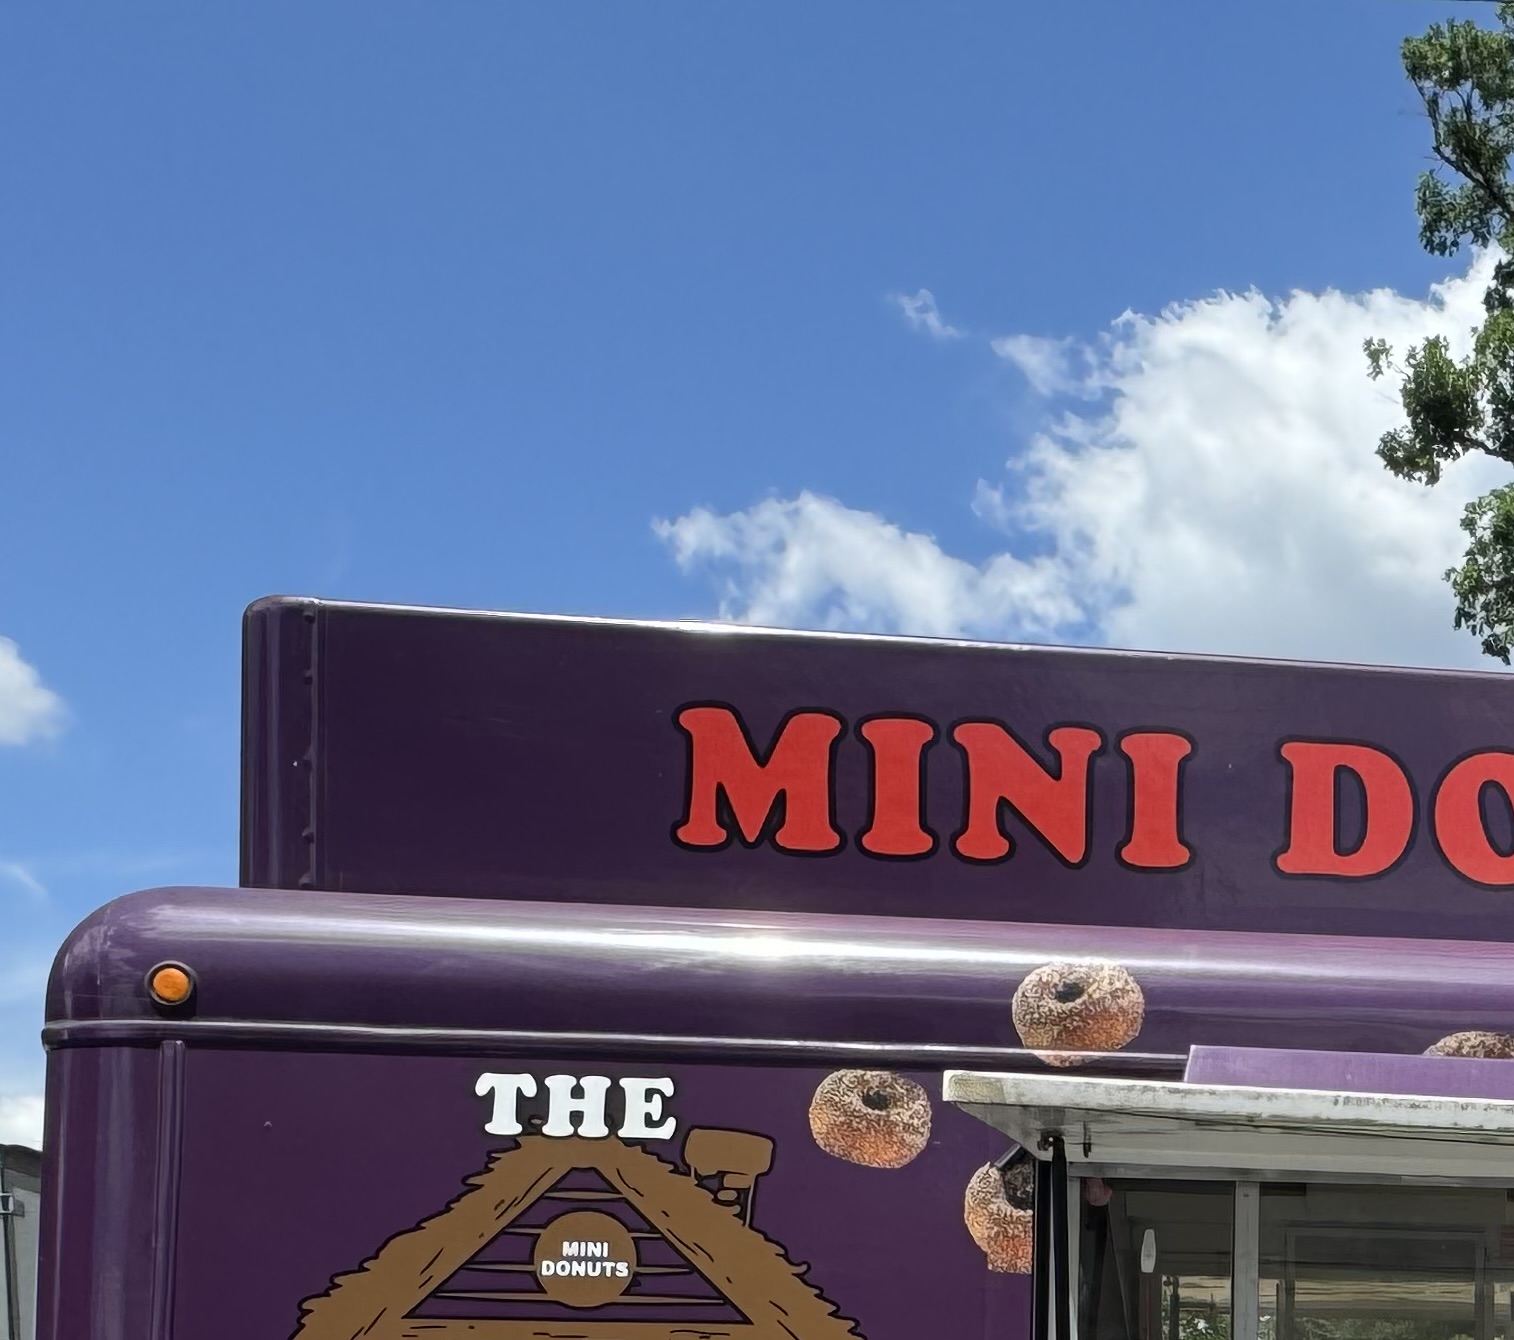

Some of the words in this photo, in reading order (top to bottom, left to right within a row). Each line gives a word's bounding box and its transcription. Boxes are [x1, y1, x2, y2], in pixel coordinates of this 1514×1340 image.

[674, 704, 1194, 870] MINI
[475, 1072, 677, 1138] THE
[540, 1261, 630, 1279] DONUTS
[561, 1241, 610, 1259] MINI
